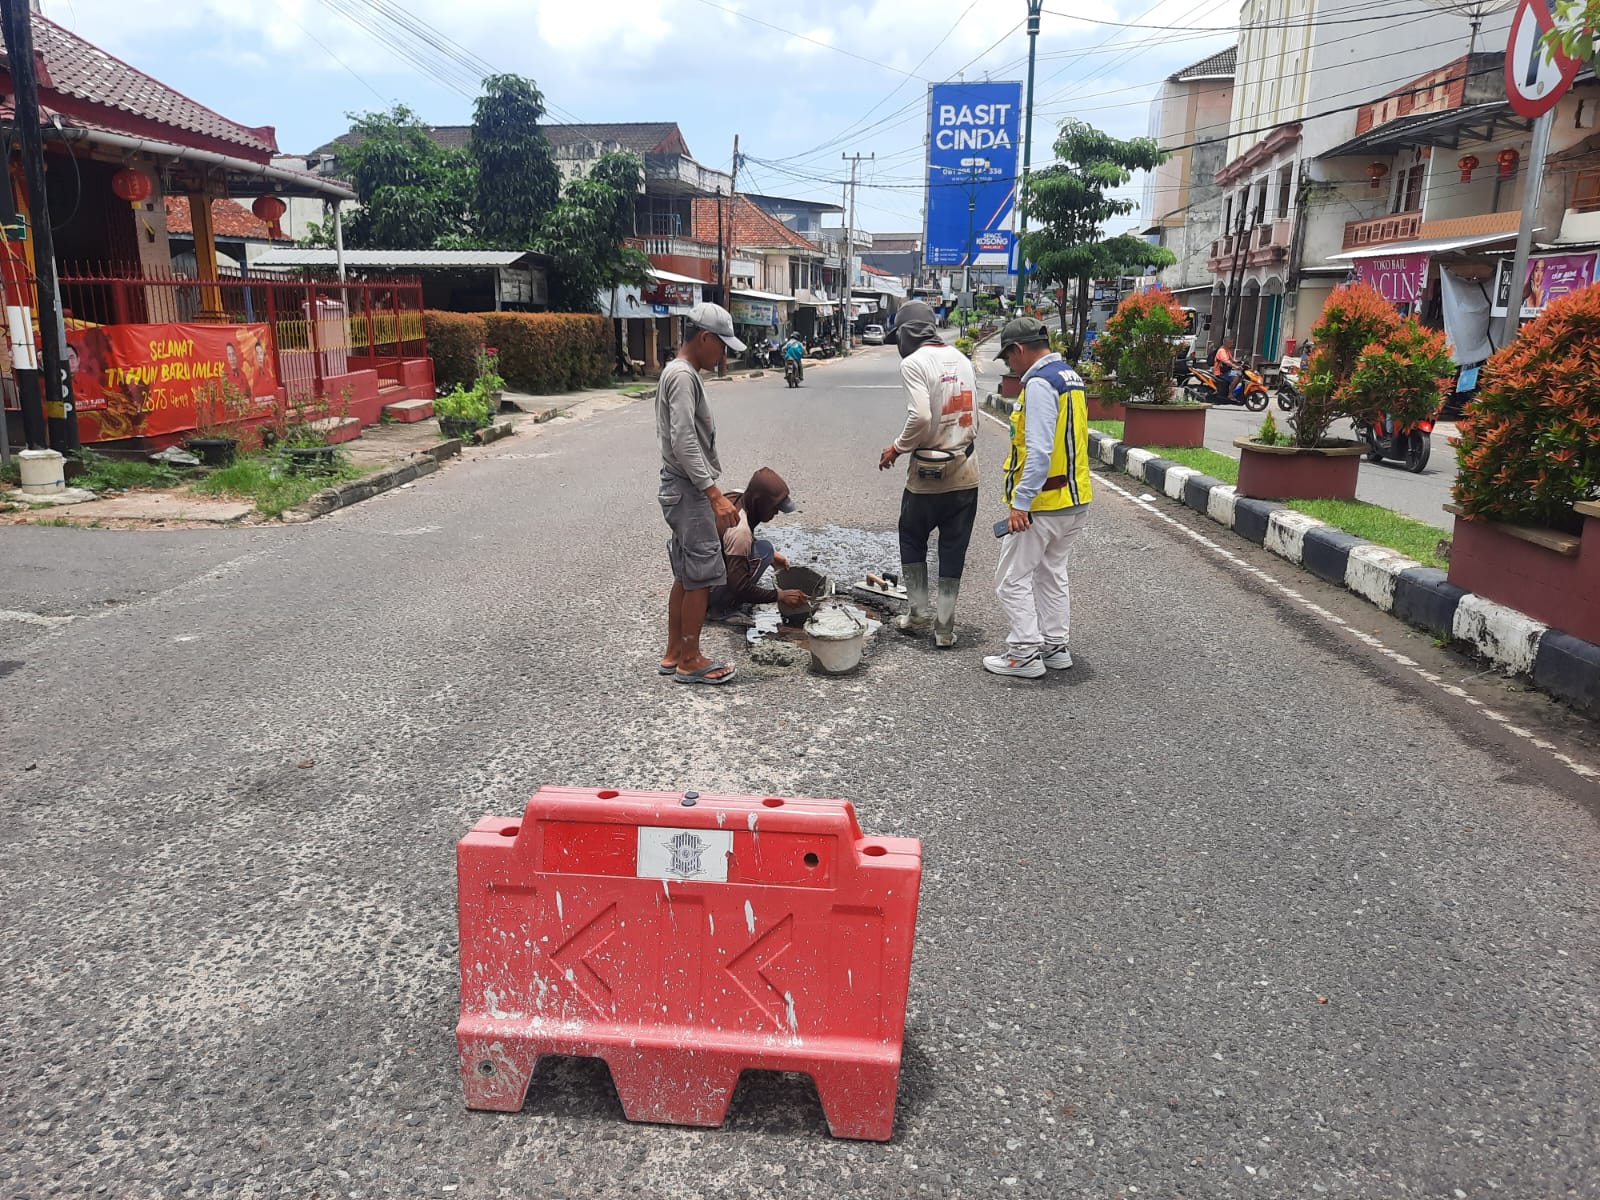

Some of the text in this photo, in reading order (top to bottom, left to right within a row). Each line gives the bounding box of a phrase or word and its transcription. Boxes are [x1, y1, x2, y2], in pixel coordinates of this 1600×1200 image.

[939, 104, 1011, 126] BASIT
[936, 128, 1011, 150] CINDA
[976, 237, 1008, 246] KOSONG
[1373, 258, 1407, 272] TOKO BAJU
[105, 360, 225, 388] TAHUN BARU IMLEK
